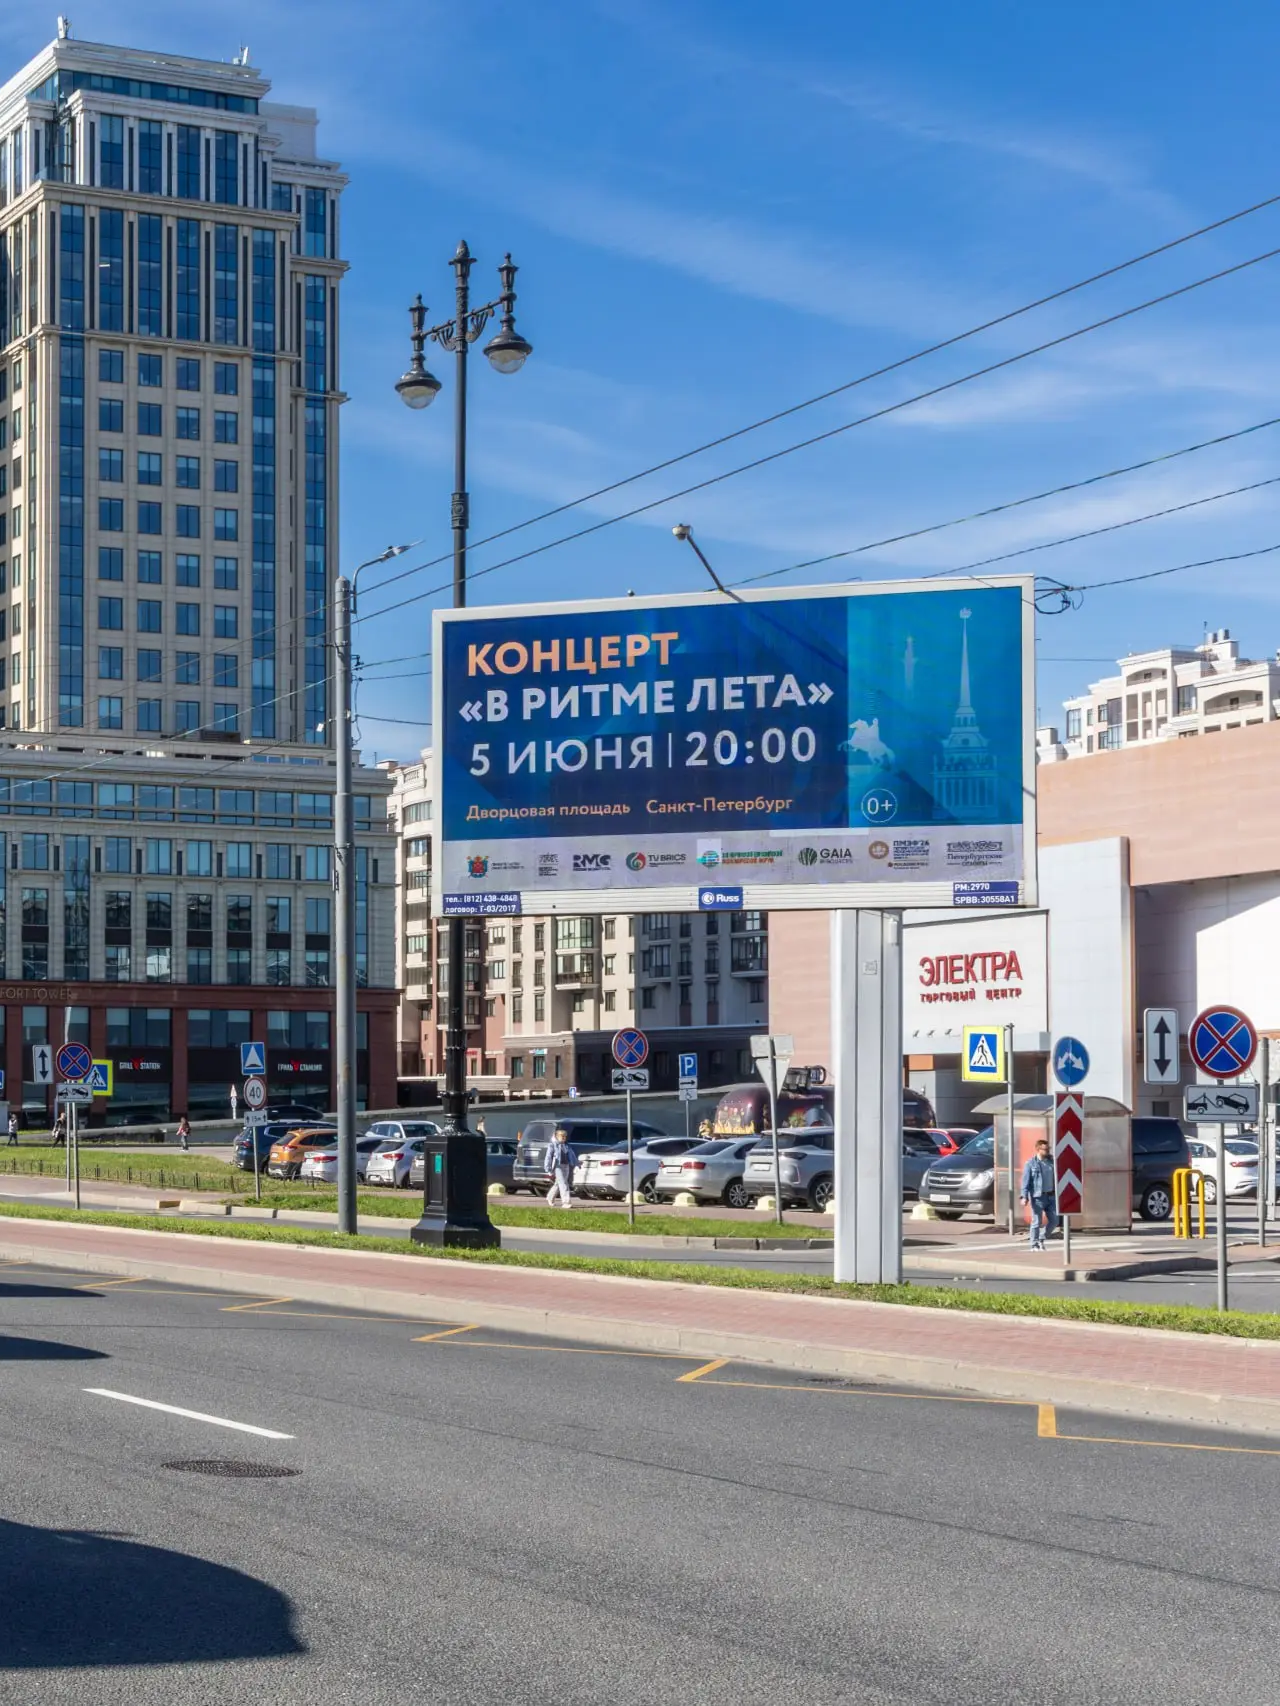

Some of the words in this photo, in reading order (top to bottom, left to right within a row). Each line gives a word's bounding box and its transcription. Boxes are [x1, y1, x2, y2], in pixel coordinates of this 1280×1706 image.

[467, 632, 679, 676] КОНЦЕРТ
[458, 689, 509, 722] «В
[523, 680, 675, 720] РИТМЕ
[686, 673, 835, 712] ЛЕТА»
[470, 743, 491, 777] 5
[508, 735, 653, 775] ИЮНЯ
[685, 726, 817, 767] 20:00
[466, 805, 555, 822] Дворцовая
[559, 802, 631, 817] площадь
[646, 796, 795, 815] Санкт-Петербург
[867, 797, 893, 815] 0+
[820, 848, 853, 858] GAIA
[464, 895, 482, 903] (812)
[716, 894, 740, 903] Russ
[919, 950, 1023, 987] ЭЛЕКТРА
[0, 987, 30, 999] FORT
[249, 1086, 262, 1099] 40
